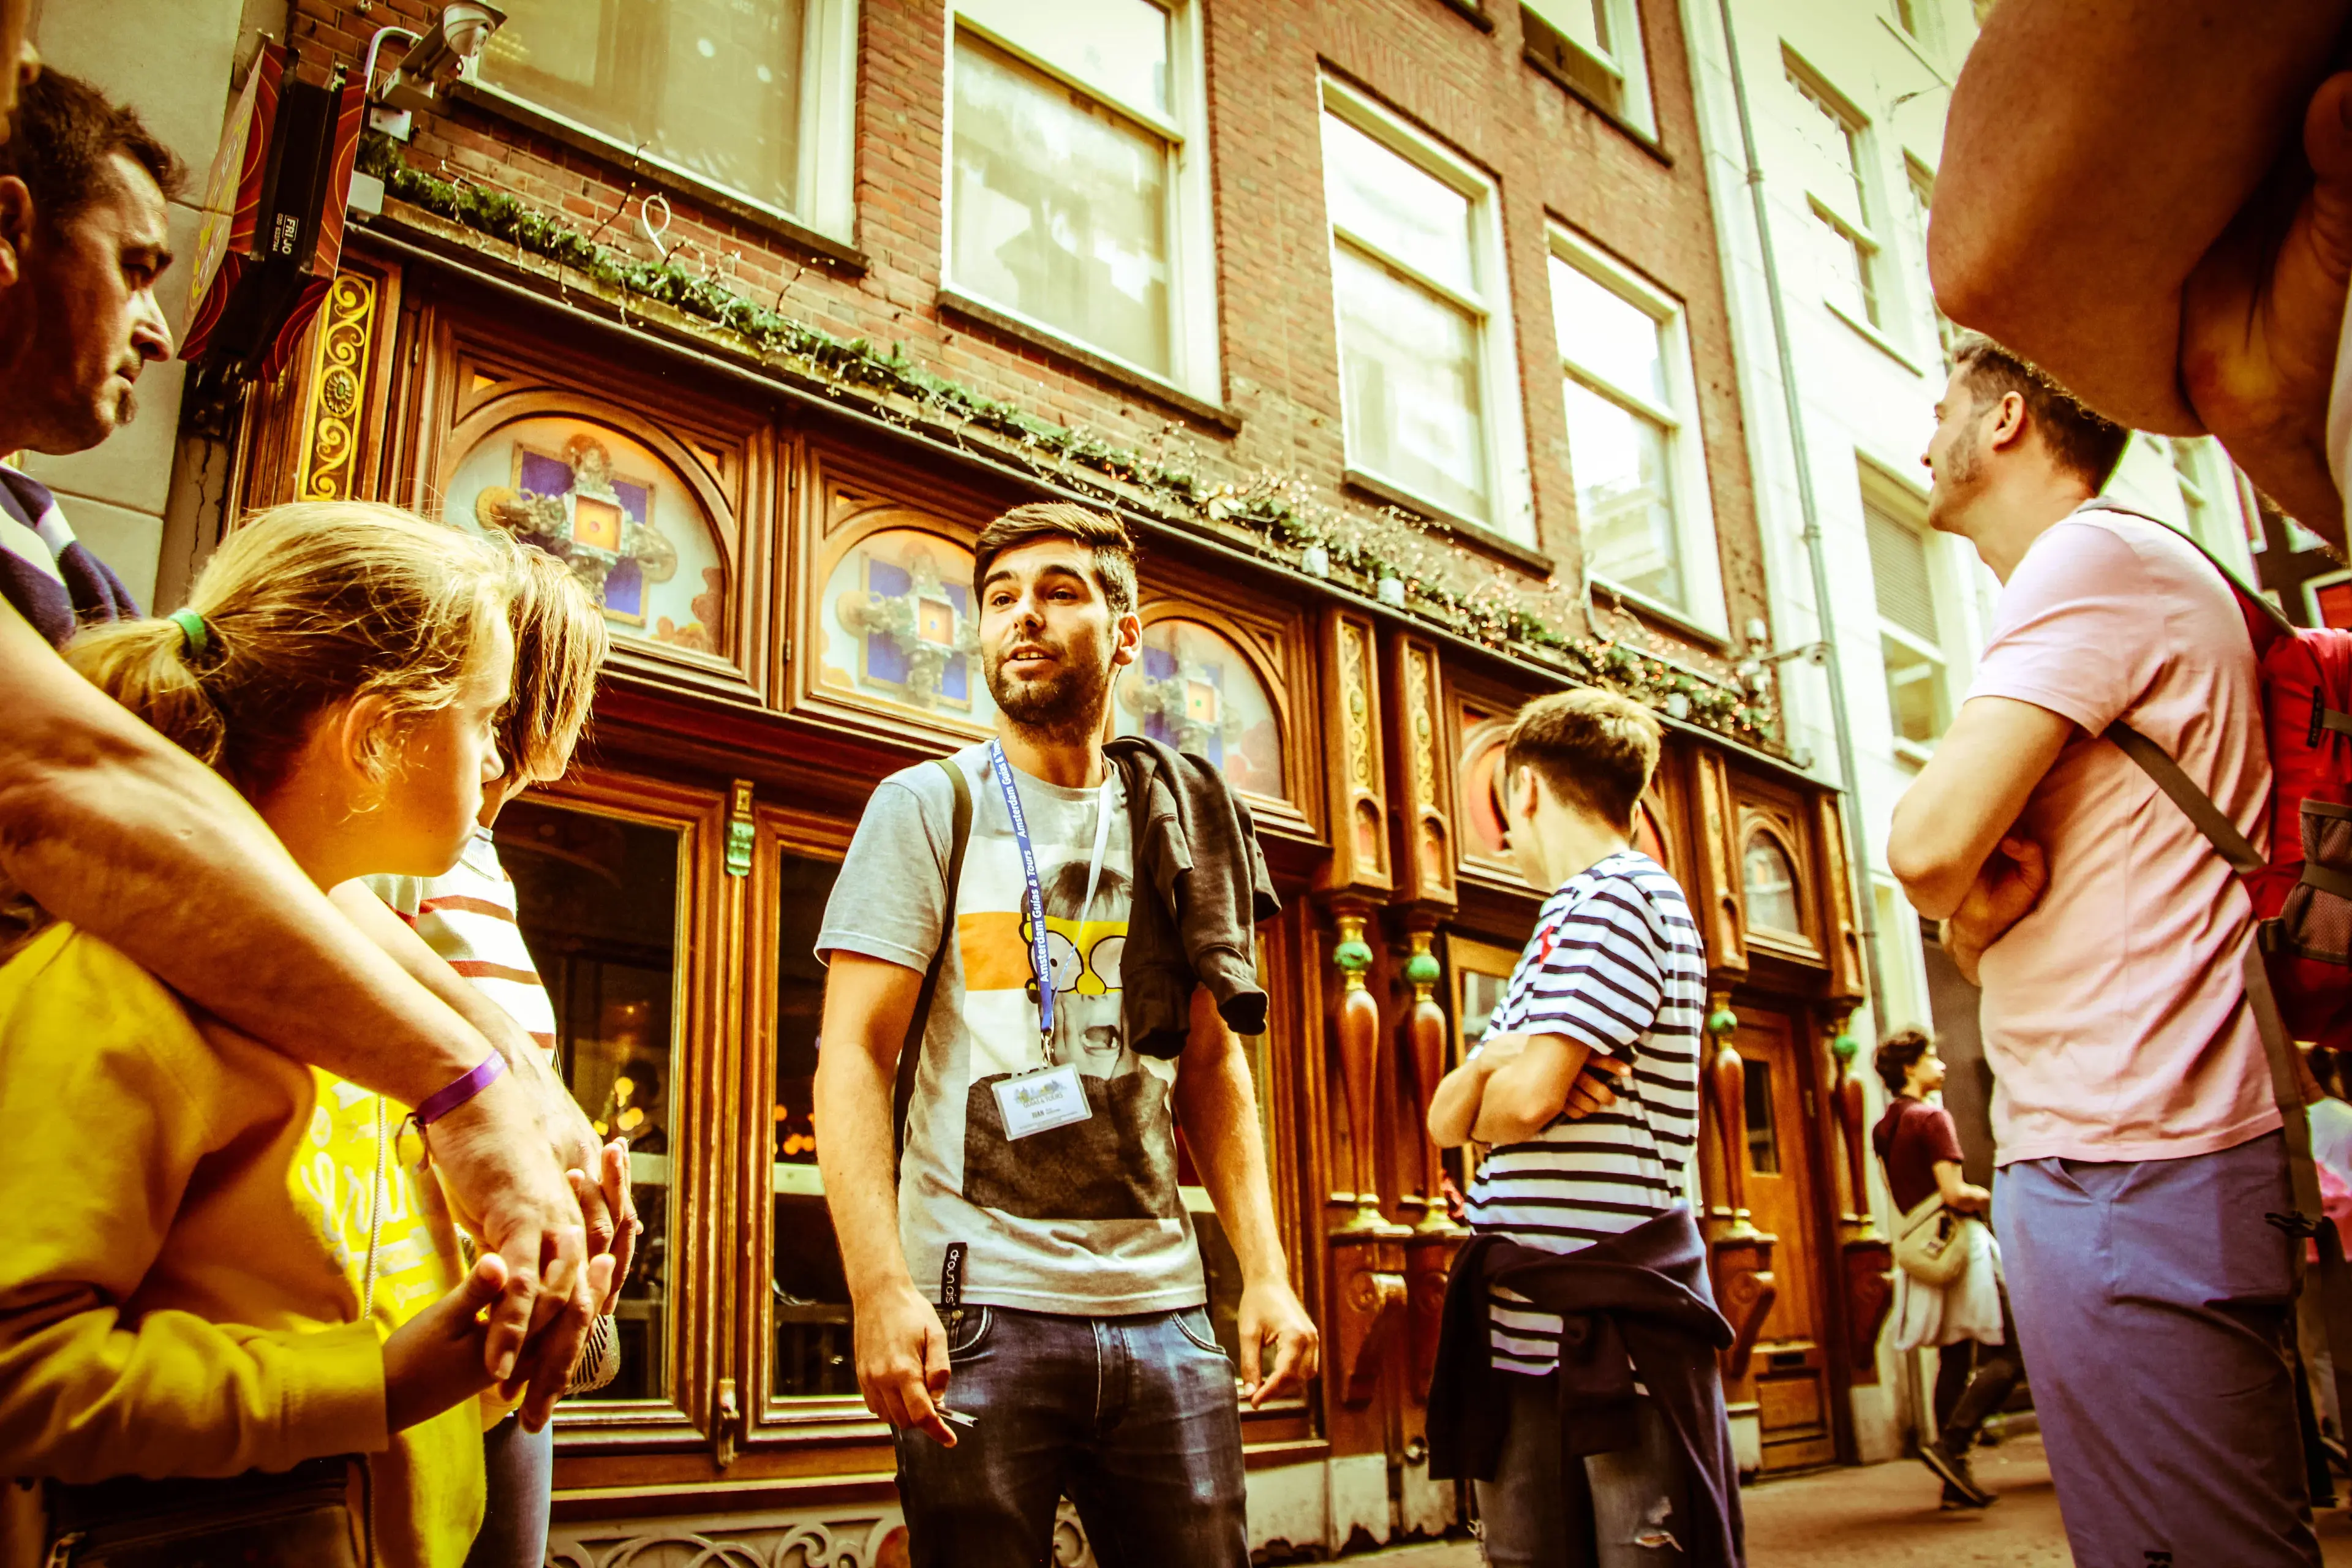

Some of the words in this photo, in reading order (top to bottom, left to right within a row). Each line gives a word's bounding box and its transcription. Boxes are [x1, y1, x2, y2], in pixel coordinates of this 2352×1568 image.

[1006, 786, 1027, 838] Amsterdam
[1023, 850, 1036, 876] Tours
[1028, 879, 1038, 888] &
[1030, 889, 1042, 919] Guías
[1034, 921, 1049, 982] Amsterdam
